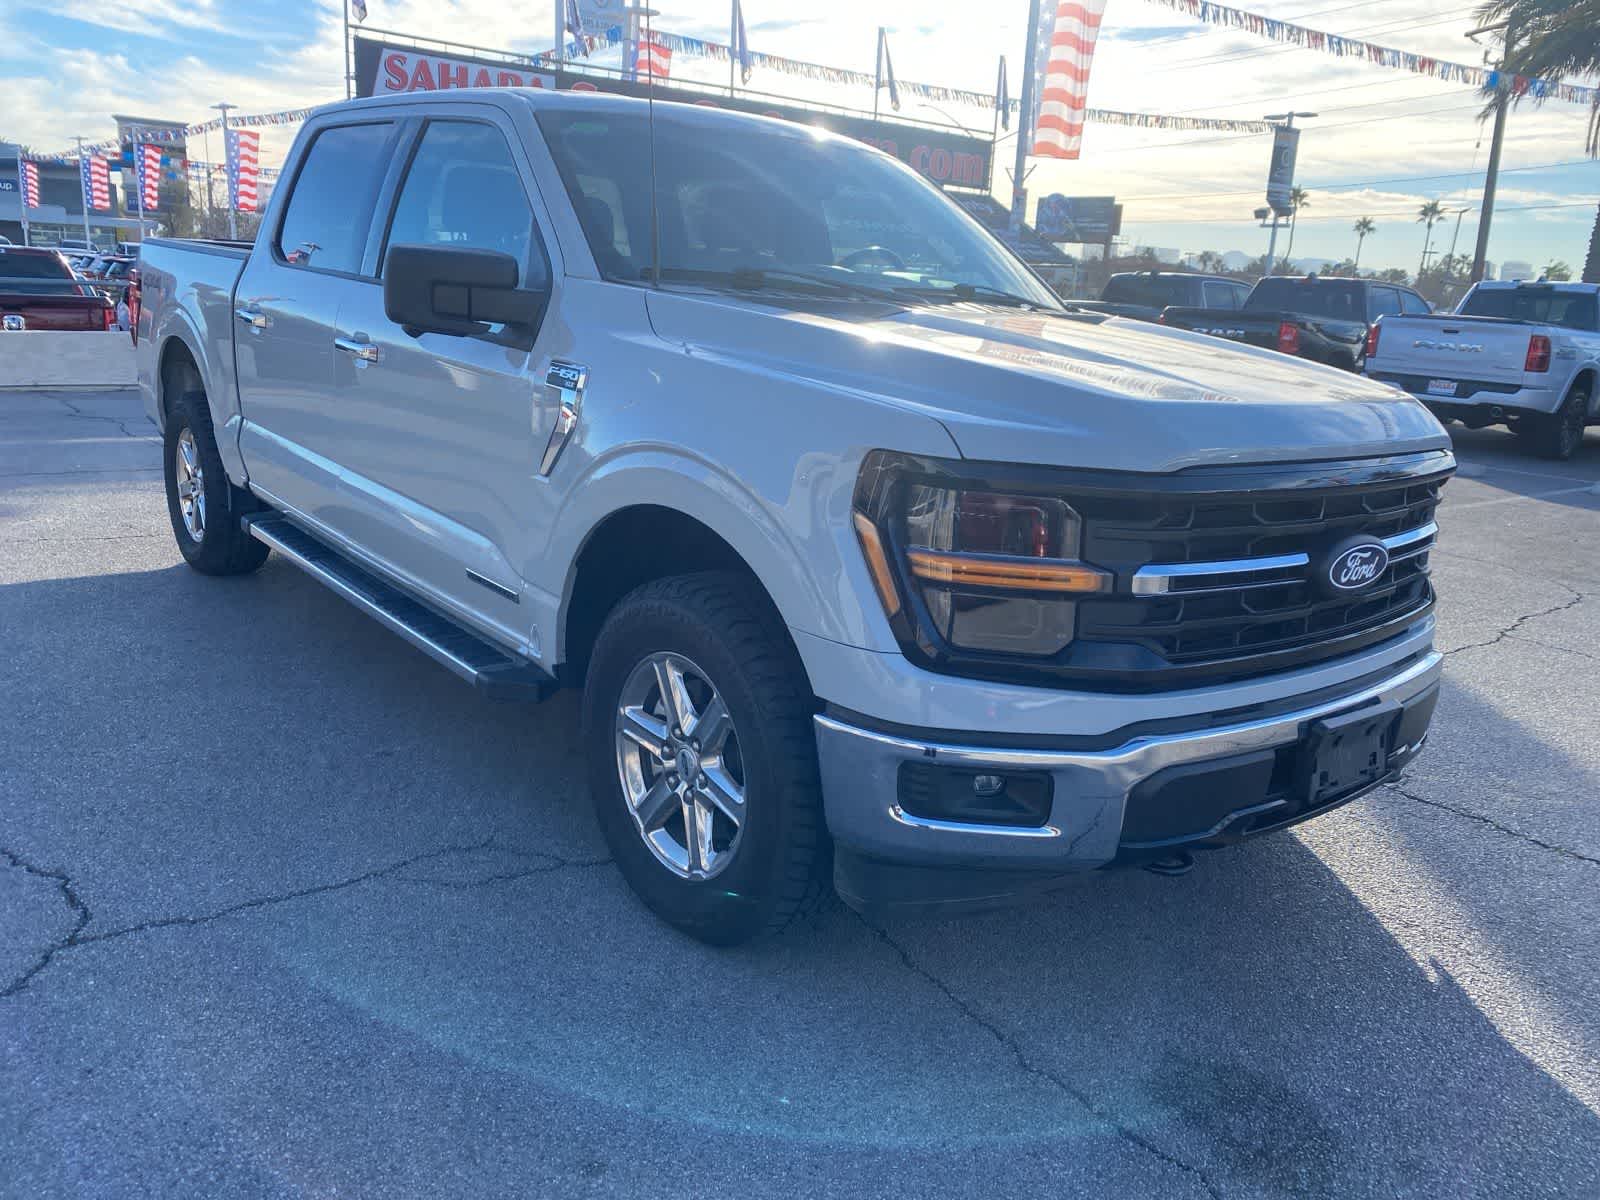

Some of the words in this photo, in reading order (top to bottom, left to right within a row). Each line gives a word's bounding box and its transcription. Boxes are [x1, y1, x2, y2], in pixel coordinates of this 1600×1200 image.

[1413, 340, 1483, 352] RAM
[548, 366, 579, 381] F-150
[1341, 551, 1380, 583] Ford
